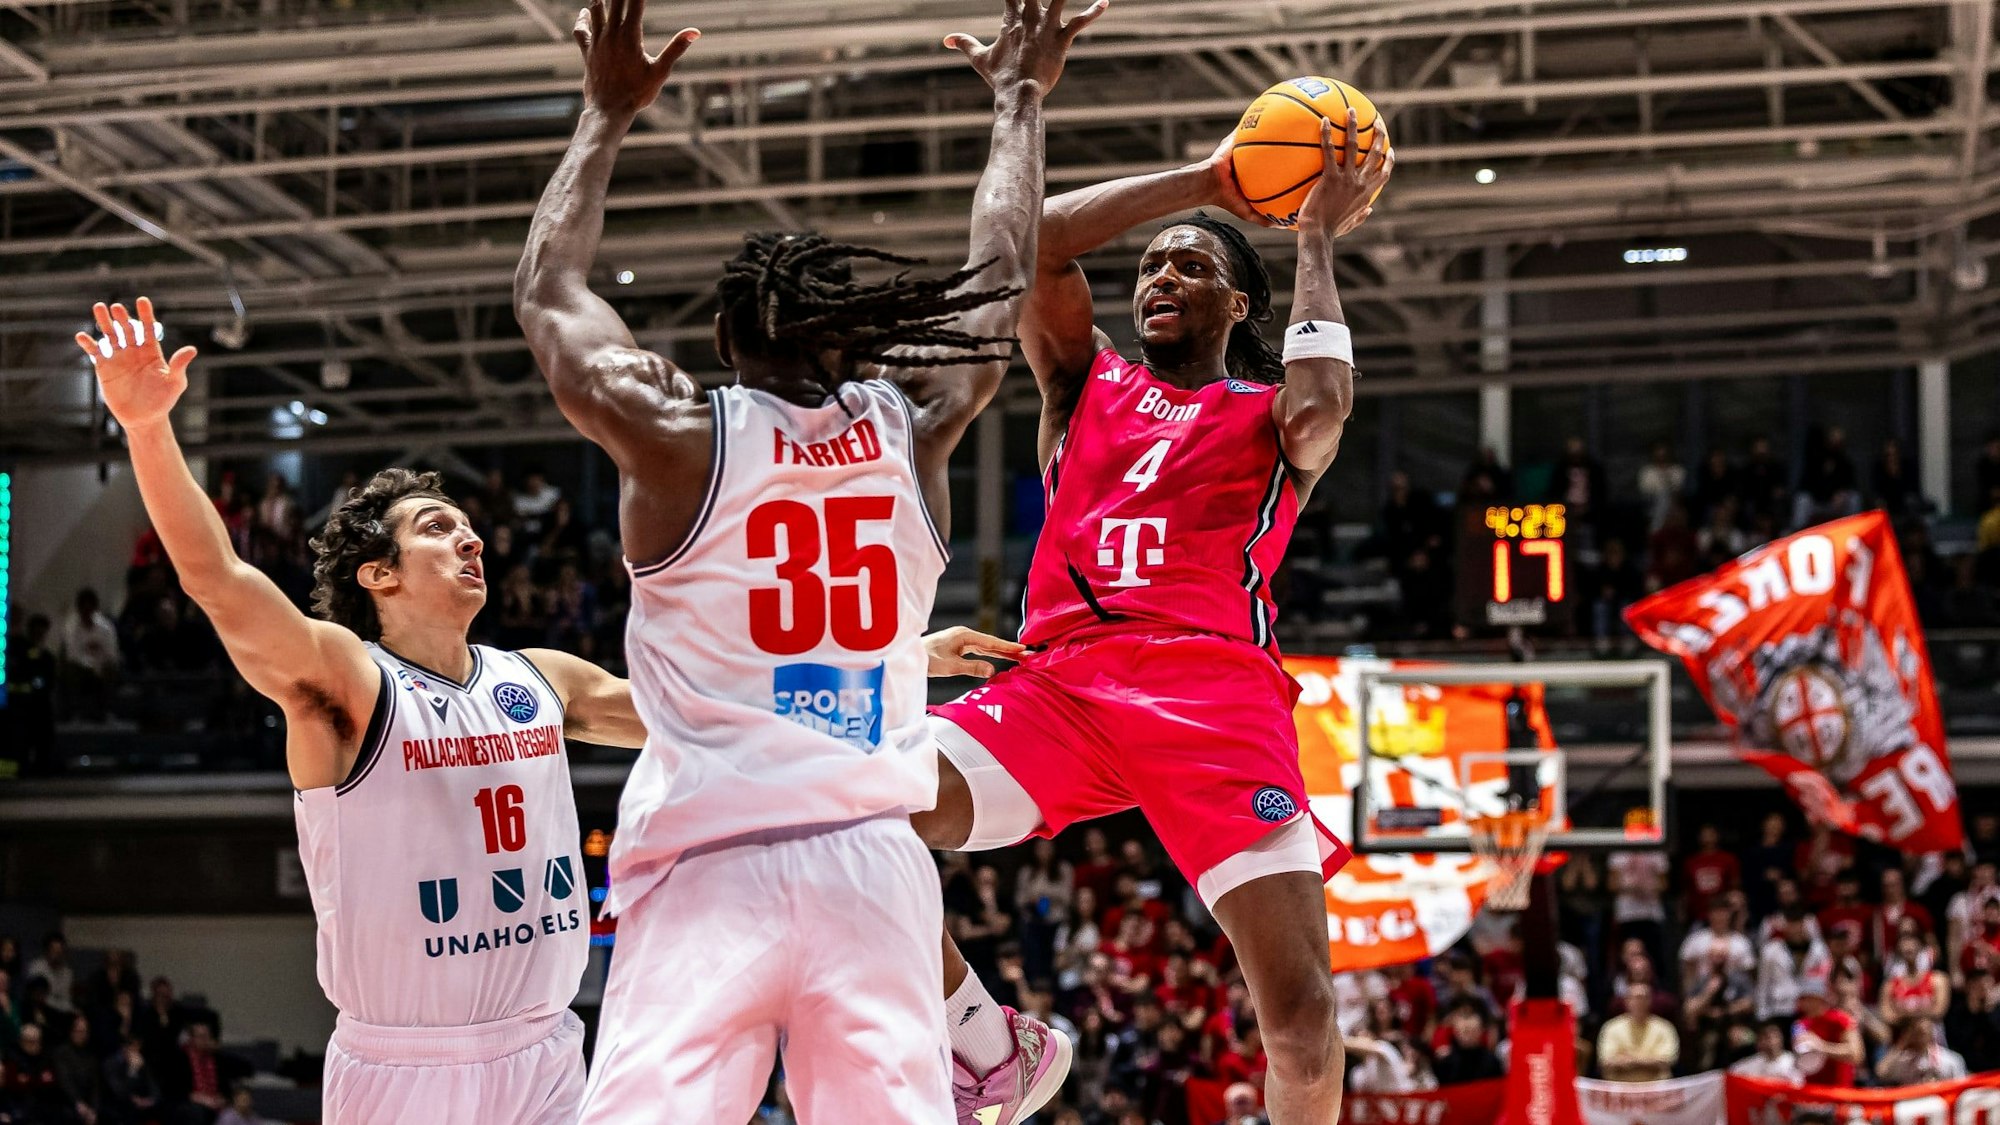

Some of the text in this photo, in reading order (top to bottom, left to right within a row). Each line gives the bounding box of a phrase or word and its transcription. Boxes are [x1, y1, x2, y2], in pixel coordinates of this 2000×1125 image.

[1136, 386, 1202, 422] Bonn
[774, 419, 883, 467] FARIED
[1122, 440, 1172, 492] 4
[1485, 504, 1565, 538] 4:25
[746, 496, 898, 655] 35
[1493, 539, 1564, 604] 17
[774, 688, 875, 715] SPORT
[403, 732, 515, 771] PALLACANESTRO
[474, 785, 527, 854] 16
[425, 909, 580, 958] UNAHOELS
